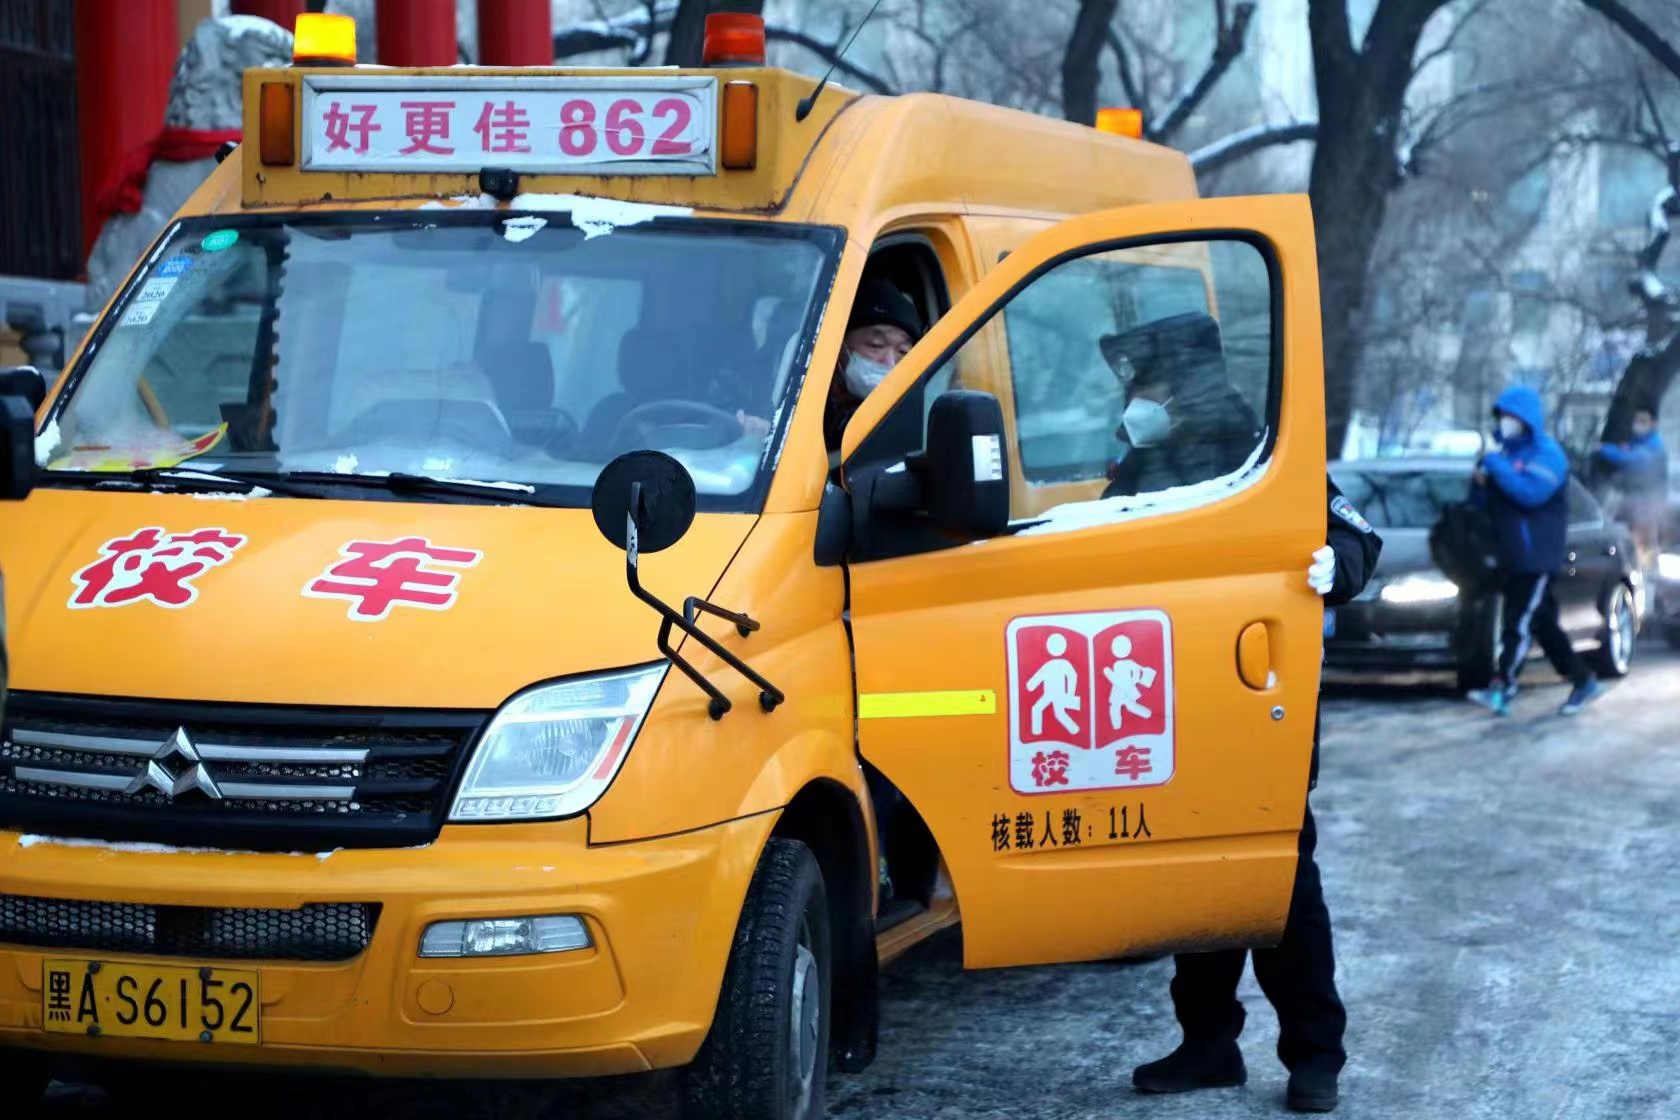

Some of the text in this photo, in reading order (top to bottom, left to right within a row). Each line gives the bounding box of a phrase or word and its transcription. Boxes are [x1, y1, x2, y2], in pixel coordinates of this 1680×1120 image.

[323, 99, 692, 156] 好更佳 862
[1031, 745, 1152, 787] 校车
